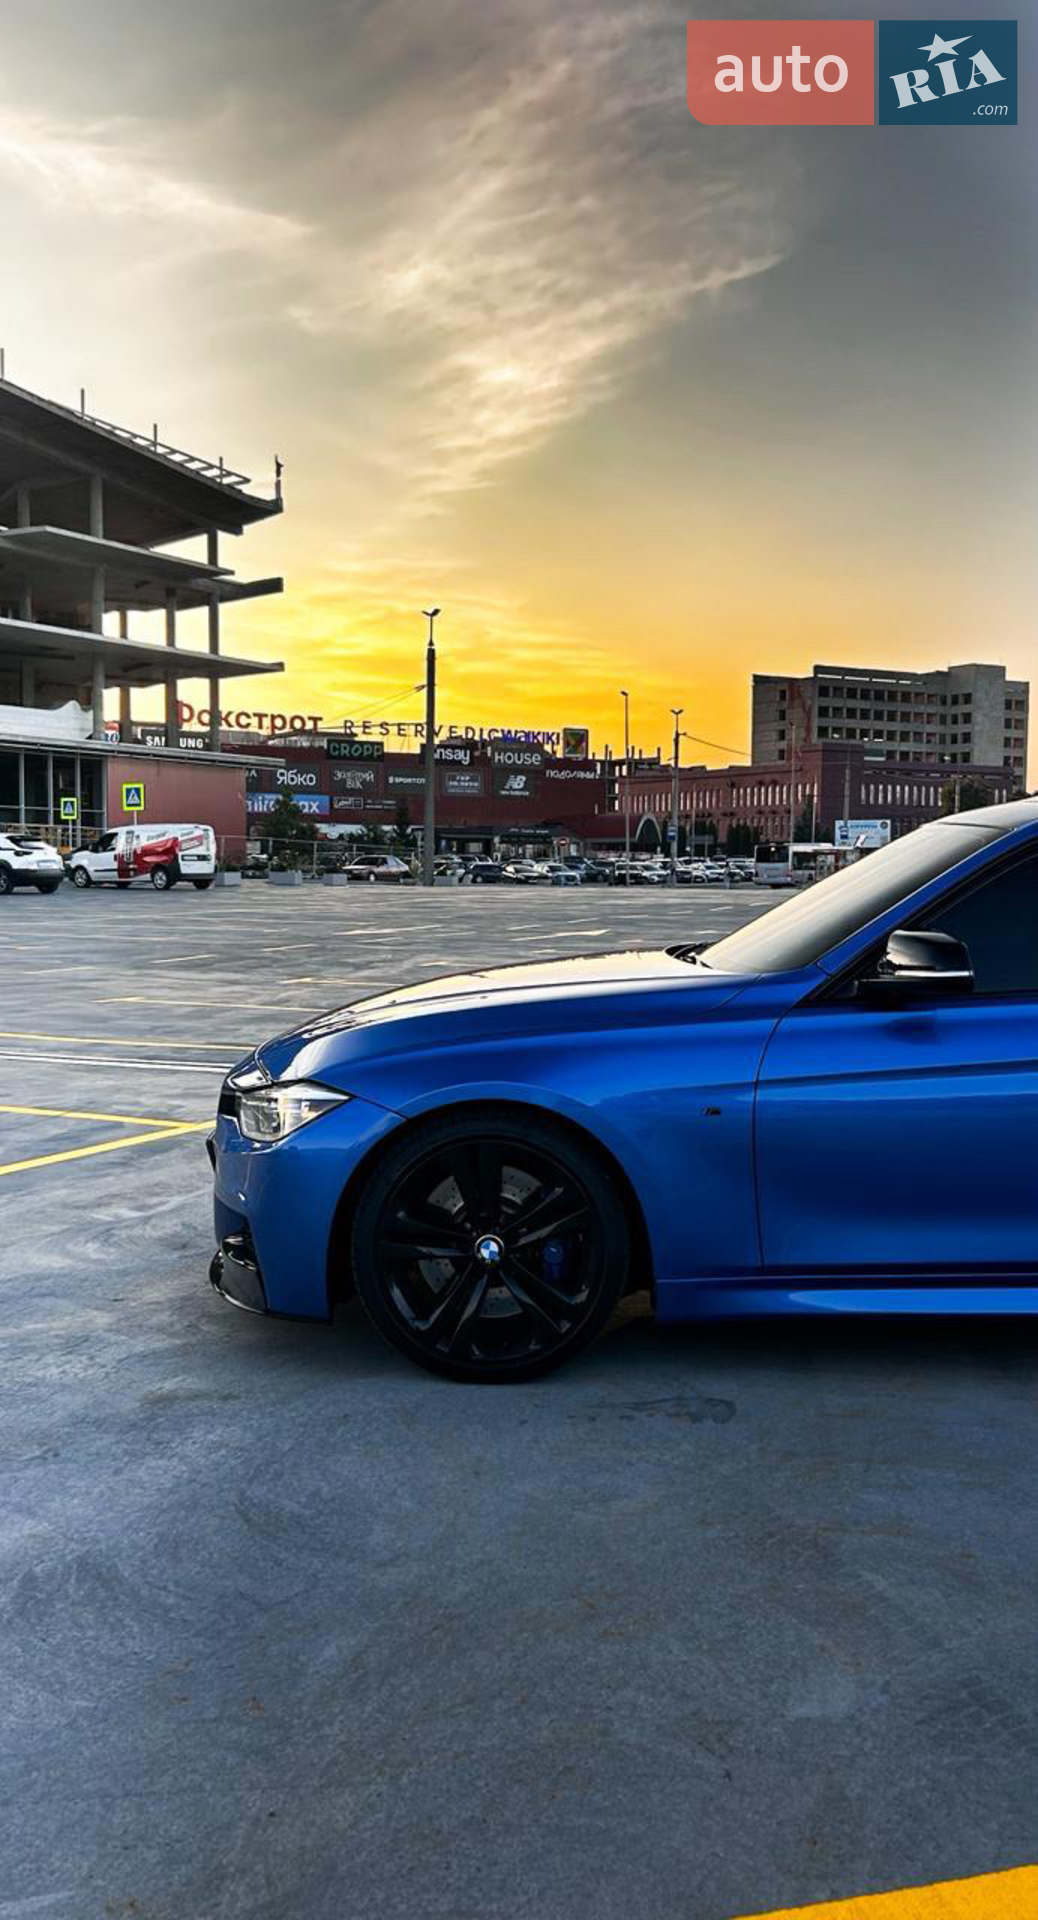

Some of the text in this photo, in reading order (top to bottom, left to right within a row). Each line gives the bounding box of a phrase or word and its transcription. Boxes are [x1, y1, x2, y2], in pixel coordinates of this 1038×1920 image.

[343, 720, 476, 741] RESERVED
[145, 736, 204, 748] SAUNG
[329, 743, 383, 758] CROPP
[277, 769, 316, 785] Ябко
